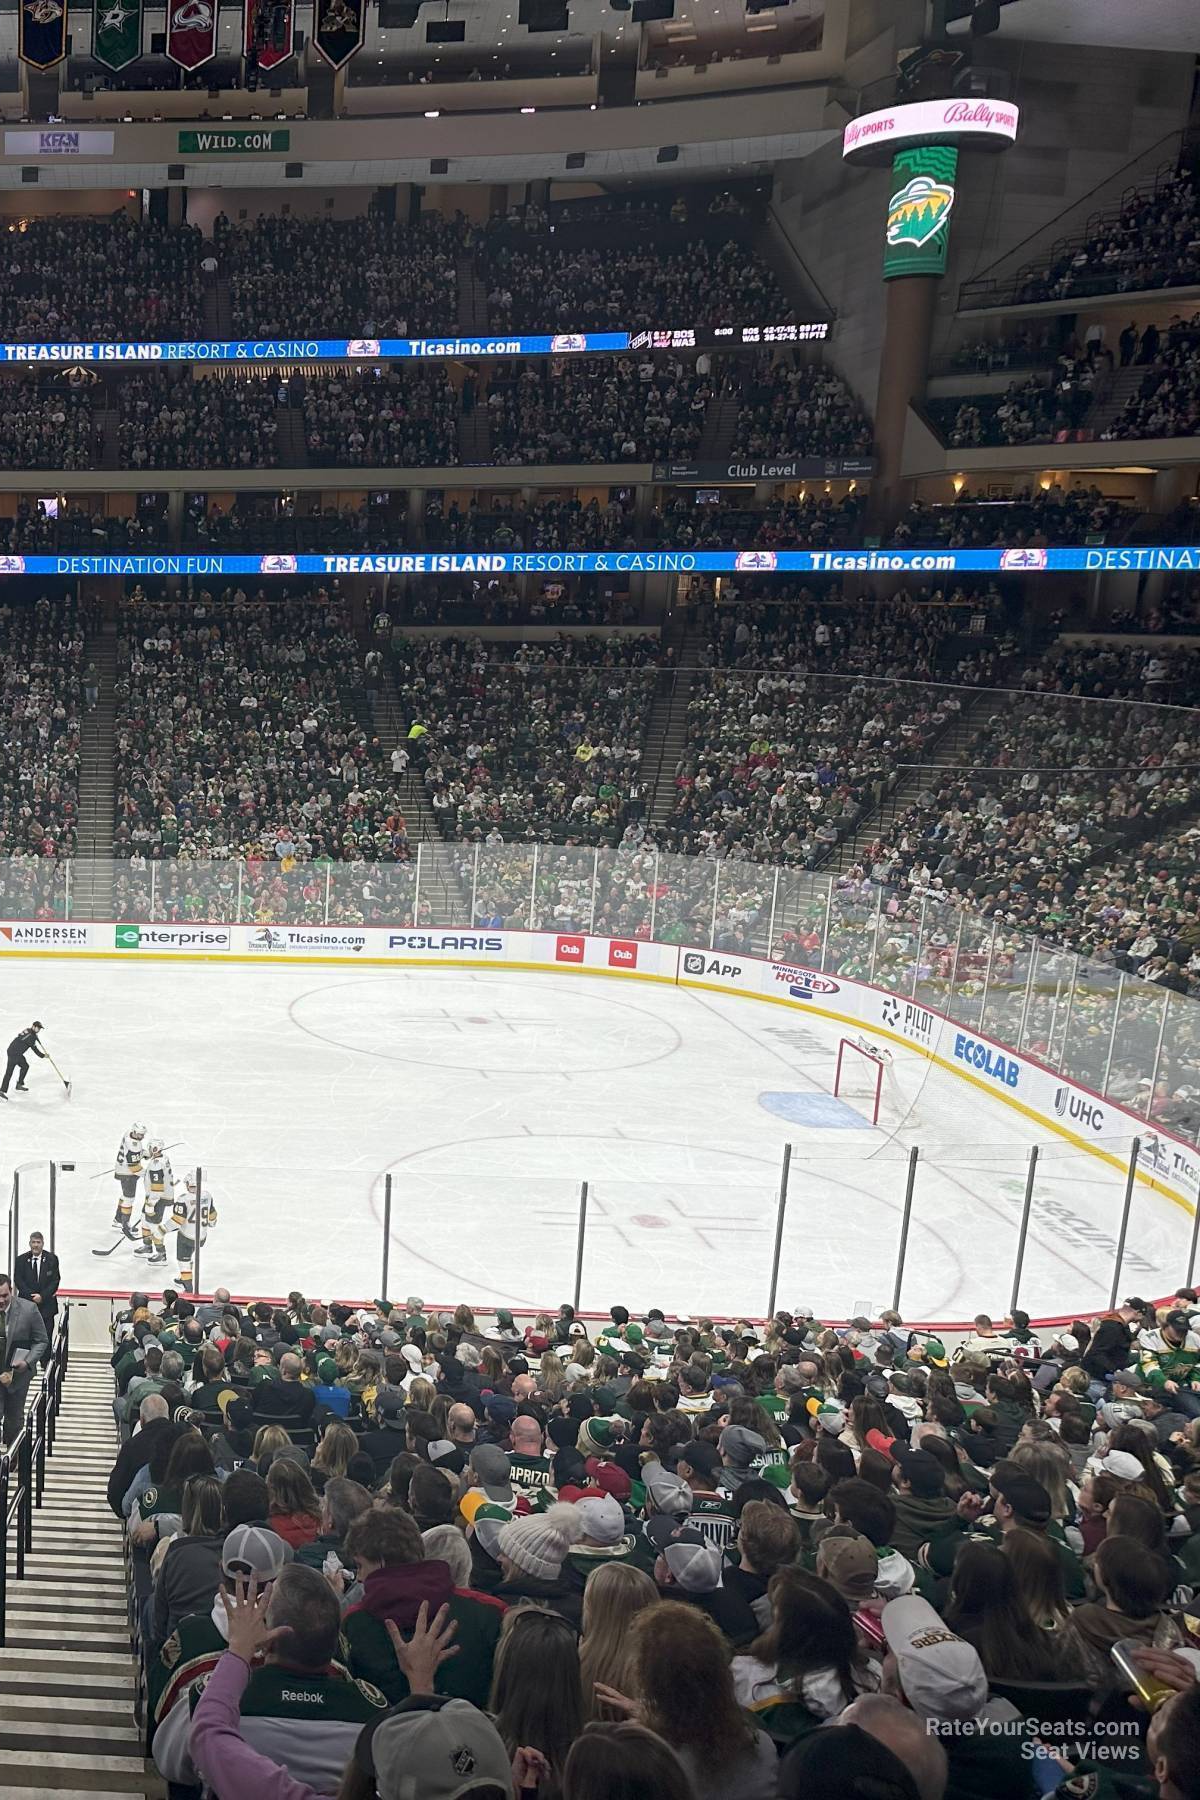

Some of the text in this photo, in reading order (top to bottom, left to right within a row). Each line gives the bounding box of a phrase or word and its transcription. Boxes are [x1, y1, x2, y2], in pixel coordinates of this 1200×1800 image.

[944, 103, 995, 128] Bally
[862, 119, 895, 138] SPORTS
[40, 132, 79, 147] KFAN
[672, 338, 695, 347] WAS
[674, 330, 694, 339] BOS
[5, 343, 318, 360] TREASURE ISLAND RESORT & CASINO
[728, 464, 796, 476] Club Level
[57, 558, 223, 573] DESTINATION FUN
[324, 554, 695, 572] TREASURE ISLAND RESORT & CASINO
[810, 553, 955, 570] TIcasino.com
[15, 928, 87, 939] ANDERSEN
[123, 930, 228, 946] enterprise
[288, 933, 365, 945] TIcasino.com
[389, 935, 502, 951] POLARIS
[561, 944, 579, 955] Cub
[614, 950, 632, 961] Cub
[707, 960, 742, 978] App
[772, 965, 816, 979] MINNESOTA
[905, 1004, 934, 1032] PILOT
[954, 1033, 1020, 1088] ECOLAB
[1069, 1096, 1104, 1131] UHC
[509, 1465, 550, 1486] APRIZO
[282, 1690, 324, 1704] Reebok
